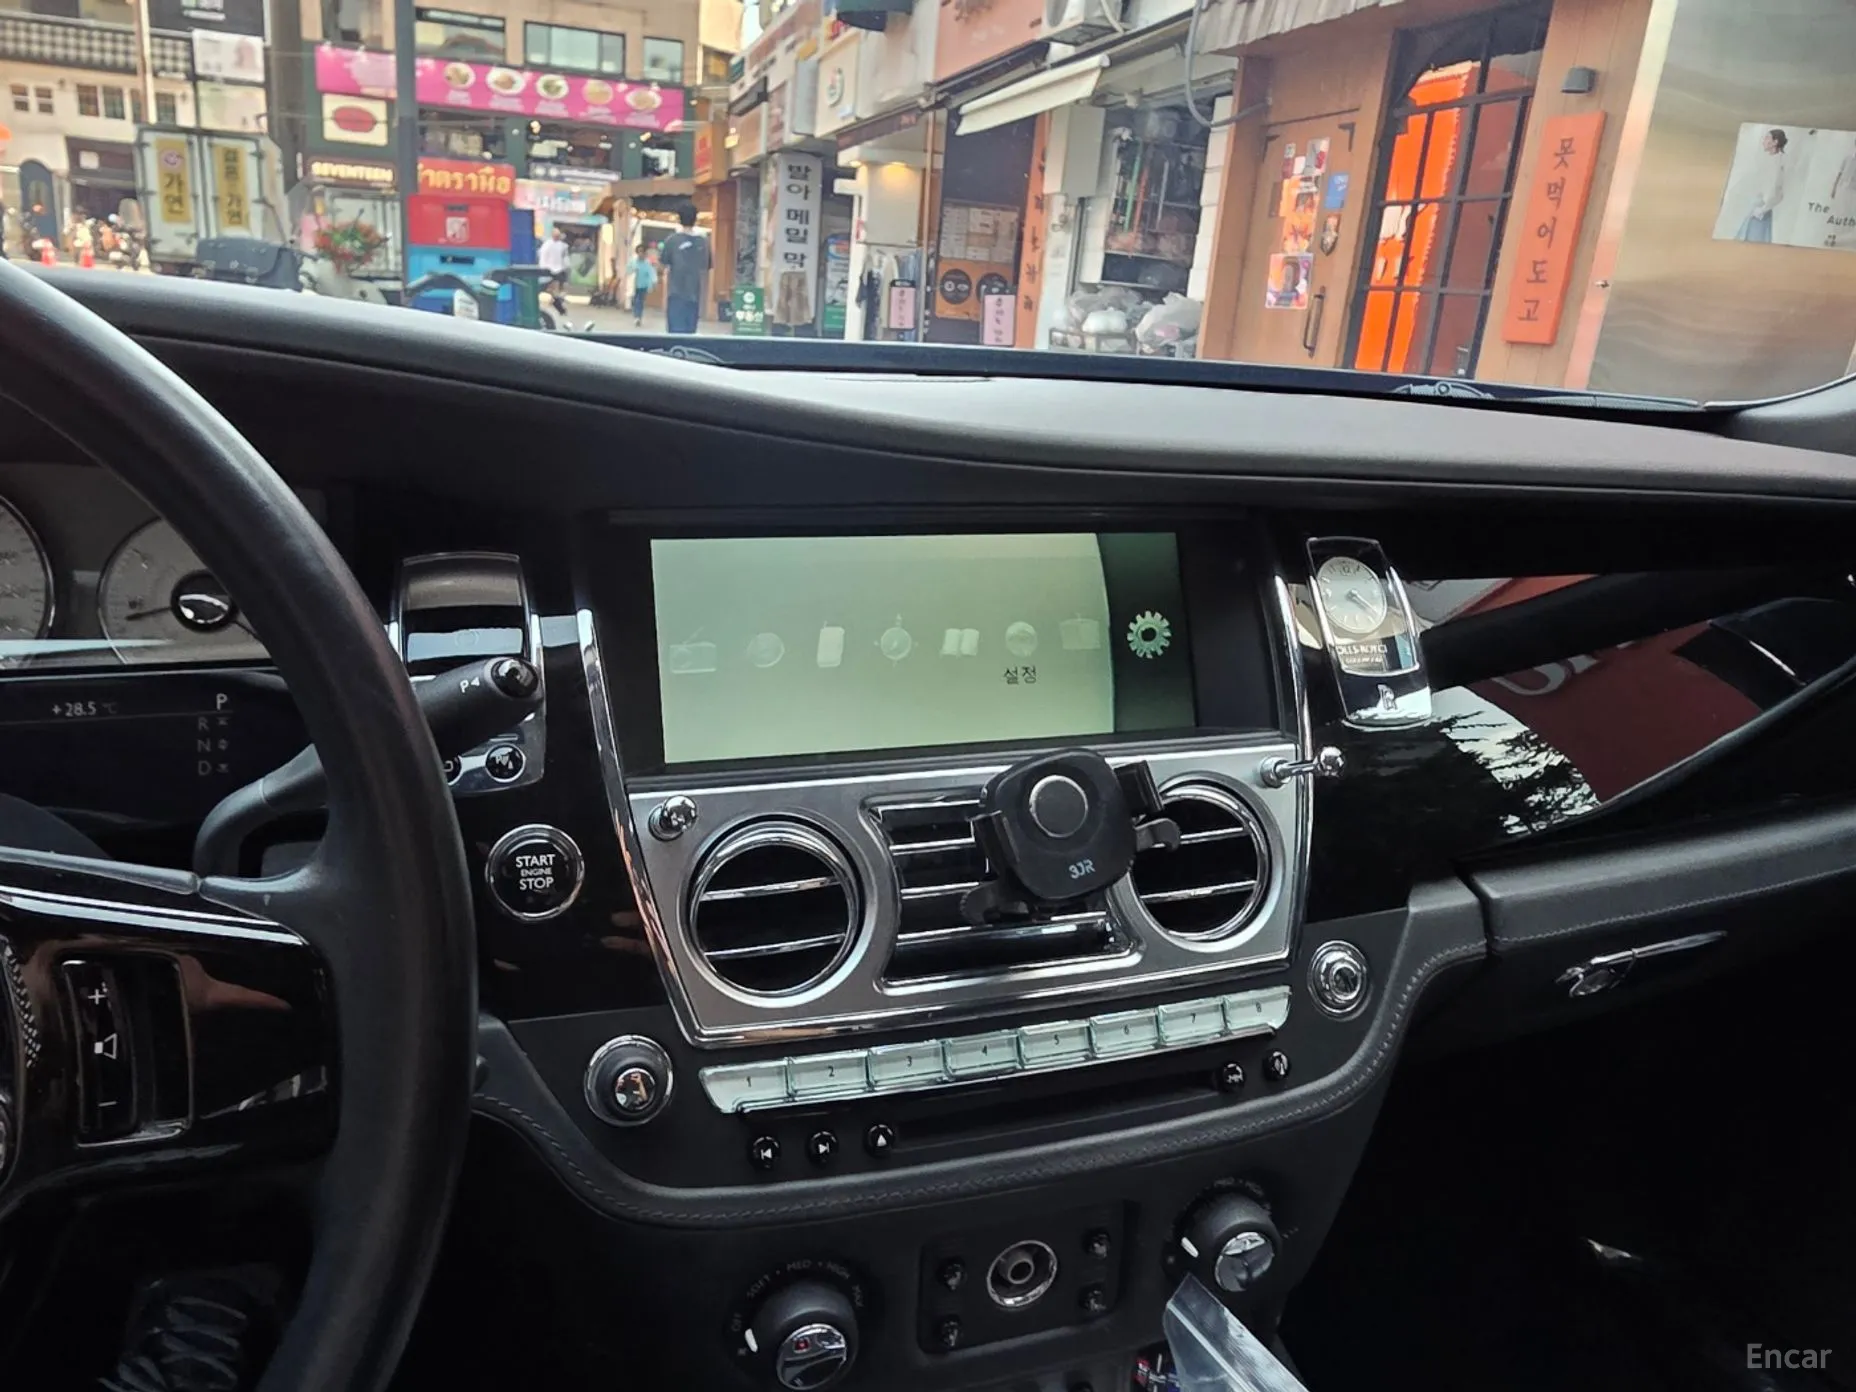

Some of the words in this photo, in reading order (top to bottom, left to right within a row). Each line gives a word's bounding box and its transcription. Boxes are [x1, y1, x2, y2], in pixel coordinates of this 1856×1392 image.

[417, 162, 512, 195] าตรามือ
[1808, 202, 1830, 213] The
[1003, 665, 1038, 685] 설정
[459, 679, 470, 692] P
[216, 693, 228, 710] P
[198, 717, 209, 731] R
[197, 739, 211, 752] N
[198, 760, 212, 775] D
[516, 854, 556, 868] START
[520, 867, 552, 877] ENGINE
[519, 877, 554, 891] STOP
[746, 1076, 752, 1087] 1
[828, 1066, 835, 1077] 2
[906, 1055, 913, 1067] 3
[981, 1045, 988, 1057] 4
[1054, 1034, 1060, 1045] 5
[1123, 1024, 1130, 1035] 6
[1191, 1013, 1197, 1024] 7
[1256, 1002, 1262, 1013] 8
[786, 1259, 813, 1271] MED
